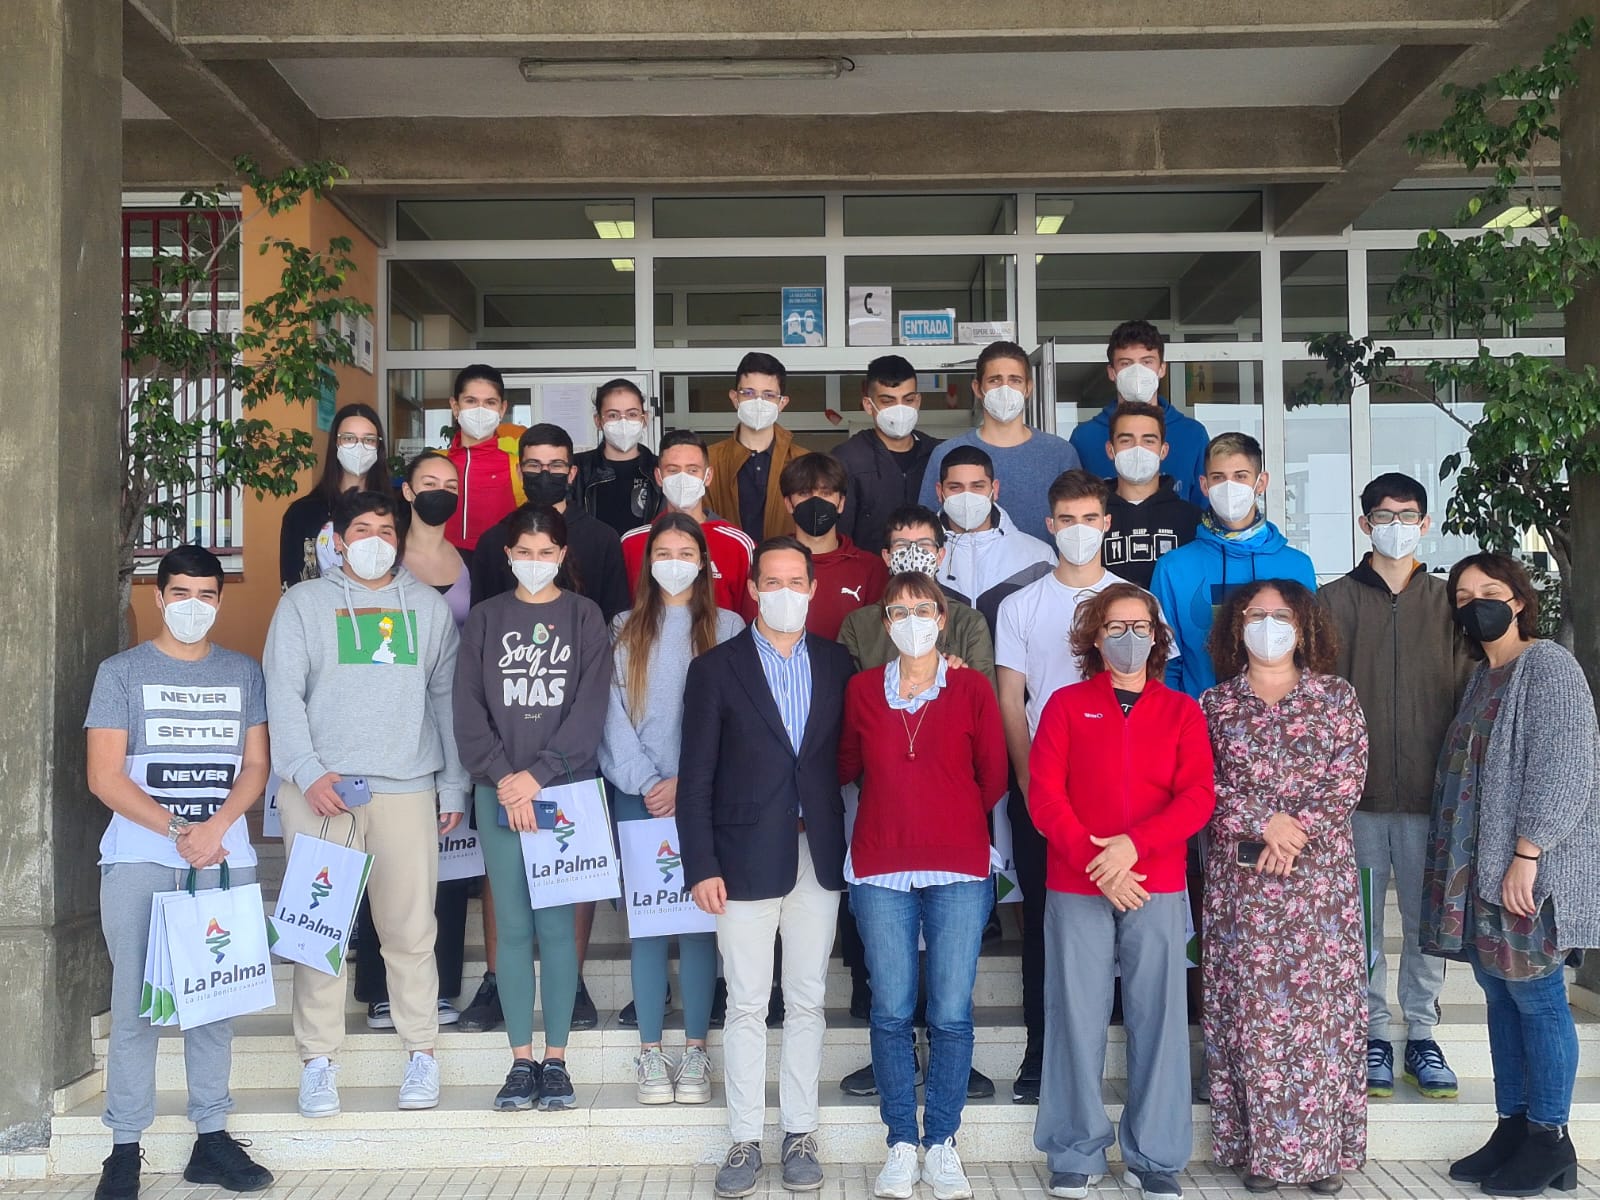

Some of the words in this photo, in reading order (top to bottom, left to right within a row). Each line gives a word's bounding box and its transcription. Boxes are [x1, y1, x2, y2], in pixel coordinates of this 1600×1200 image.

[905, 319, 949, 335] ENTRADA
[498, 631, 547, 677] Soy
[550, 635, 571, 665] lo
[160, 691, 227, 704] NEVER
[158, 726, 234, 738] SETTLE
[162, 769, 229, 782] NEVER
[160, 803, 202, 815] IVE
[438, 836, 476, 853] alma
[532, 863, 551, 879] La
[554, 855, 608, 875] Palma
[633, 891, 652, 907] La
[656, 886, 695, 905] Pal
[279, 907, 295, 924] La
[298, 914, 343, 941] Palma
[184, 977, 206, 995] La
[210, 962, 266, 988] Palma
[213, 986, 237, 997] Bonita
